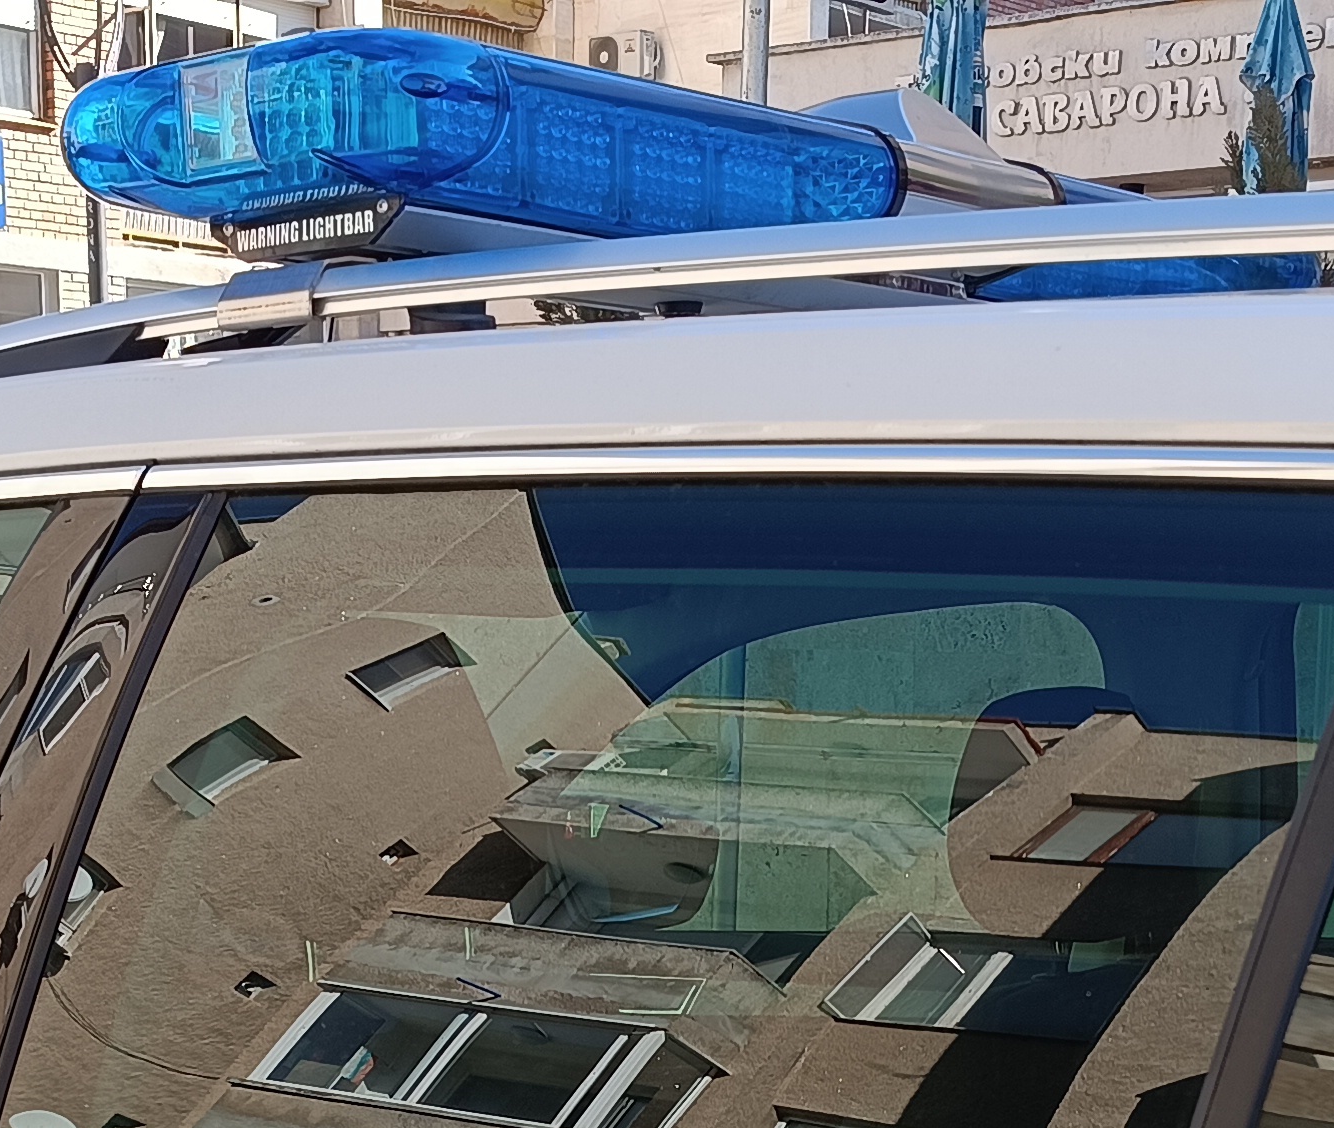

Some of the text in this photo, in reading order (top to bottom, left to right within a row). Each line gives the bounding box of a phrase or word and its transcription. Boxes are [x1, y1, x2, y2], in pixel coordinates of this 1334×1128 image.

[984, 50, 1122, 88] овски
[990, 75, 1227, 137] САВАРОНА
[236, 210, 375, 253] WARNING LIGHTBAR
